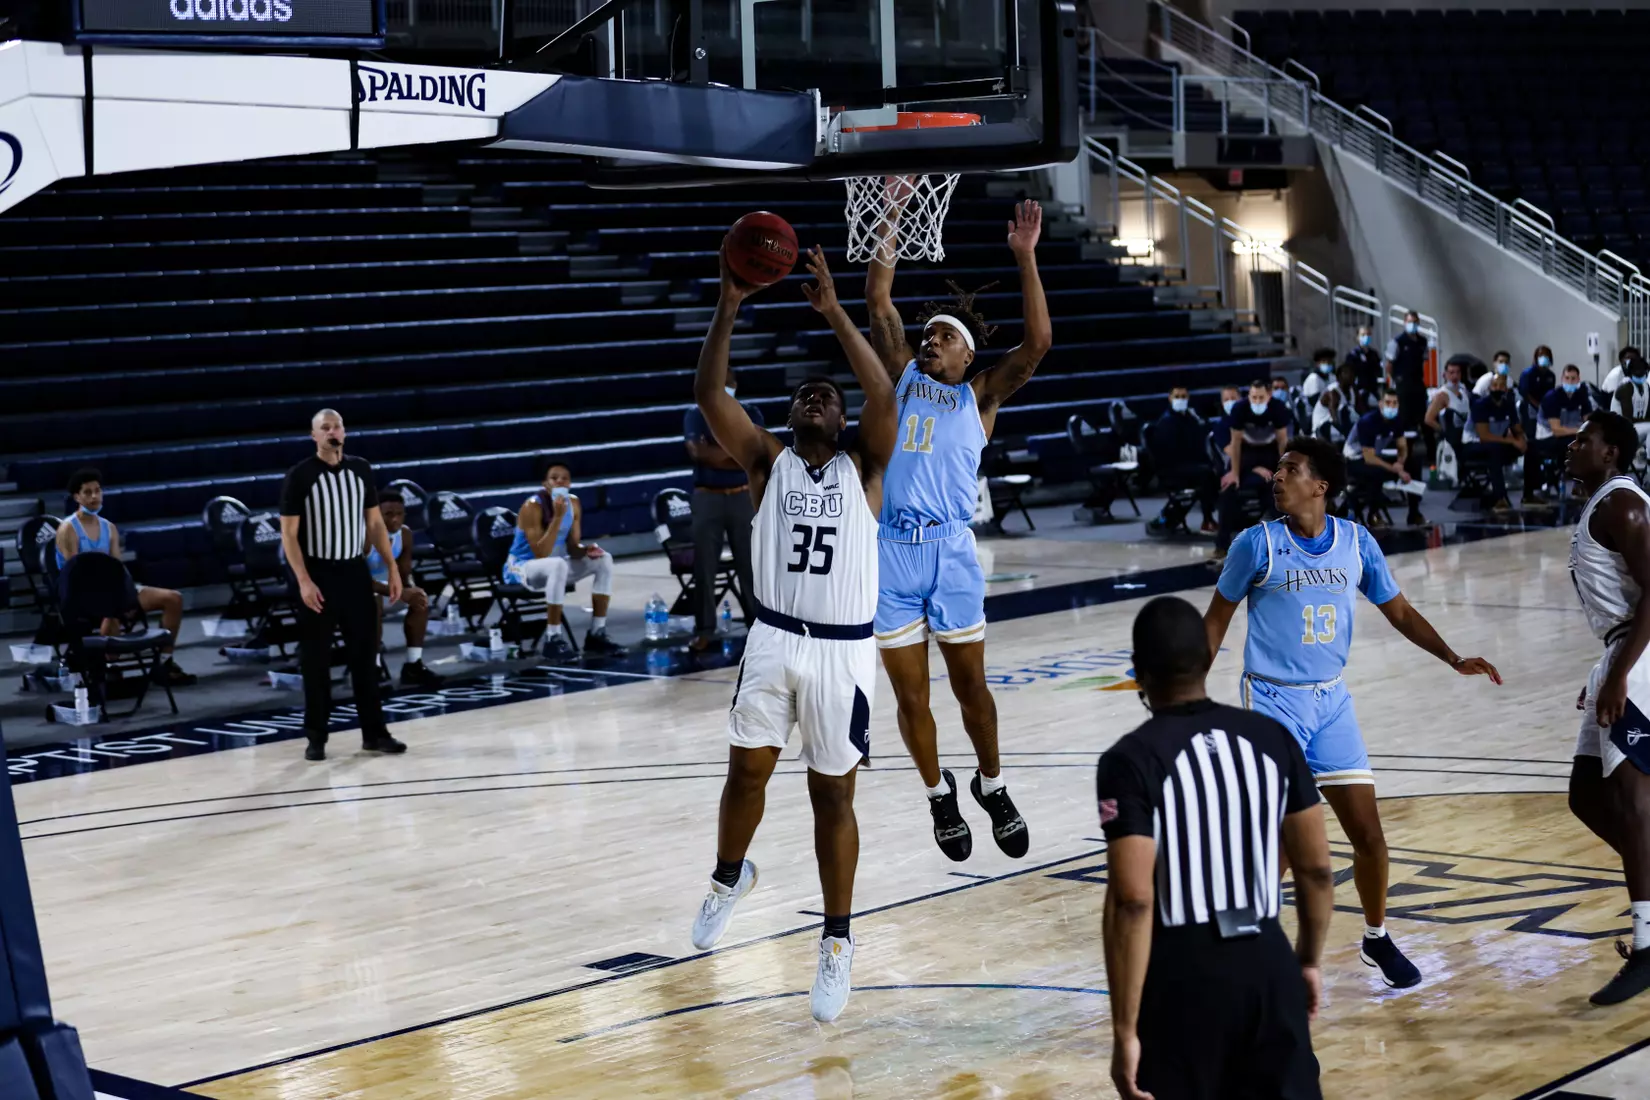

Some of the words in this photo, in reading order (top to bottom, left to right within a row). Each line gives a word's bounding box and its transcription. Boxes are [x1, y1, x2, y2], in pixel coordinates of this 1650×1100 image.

[902, 414, 935, 454] 11
[785, 491, 843, 518] CBU
[823, 482, 840, 491] WAC
[787, 524, 837, 575] 35
[1272, 567, 1348, 594] HAWKS
[1301, 604, 1336, 645] 13
[7, 732, 208, 775] PTIST
